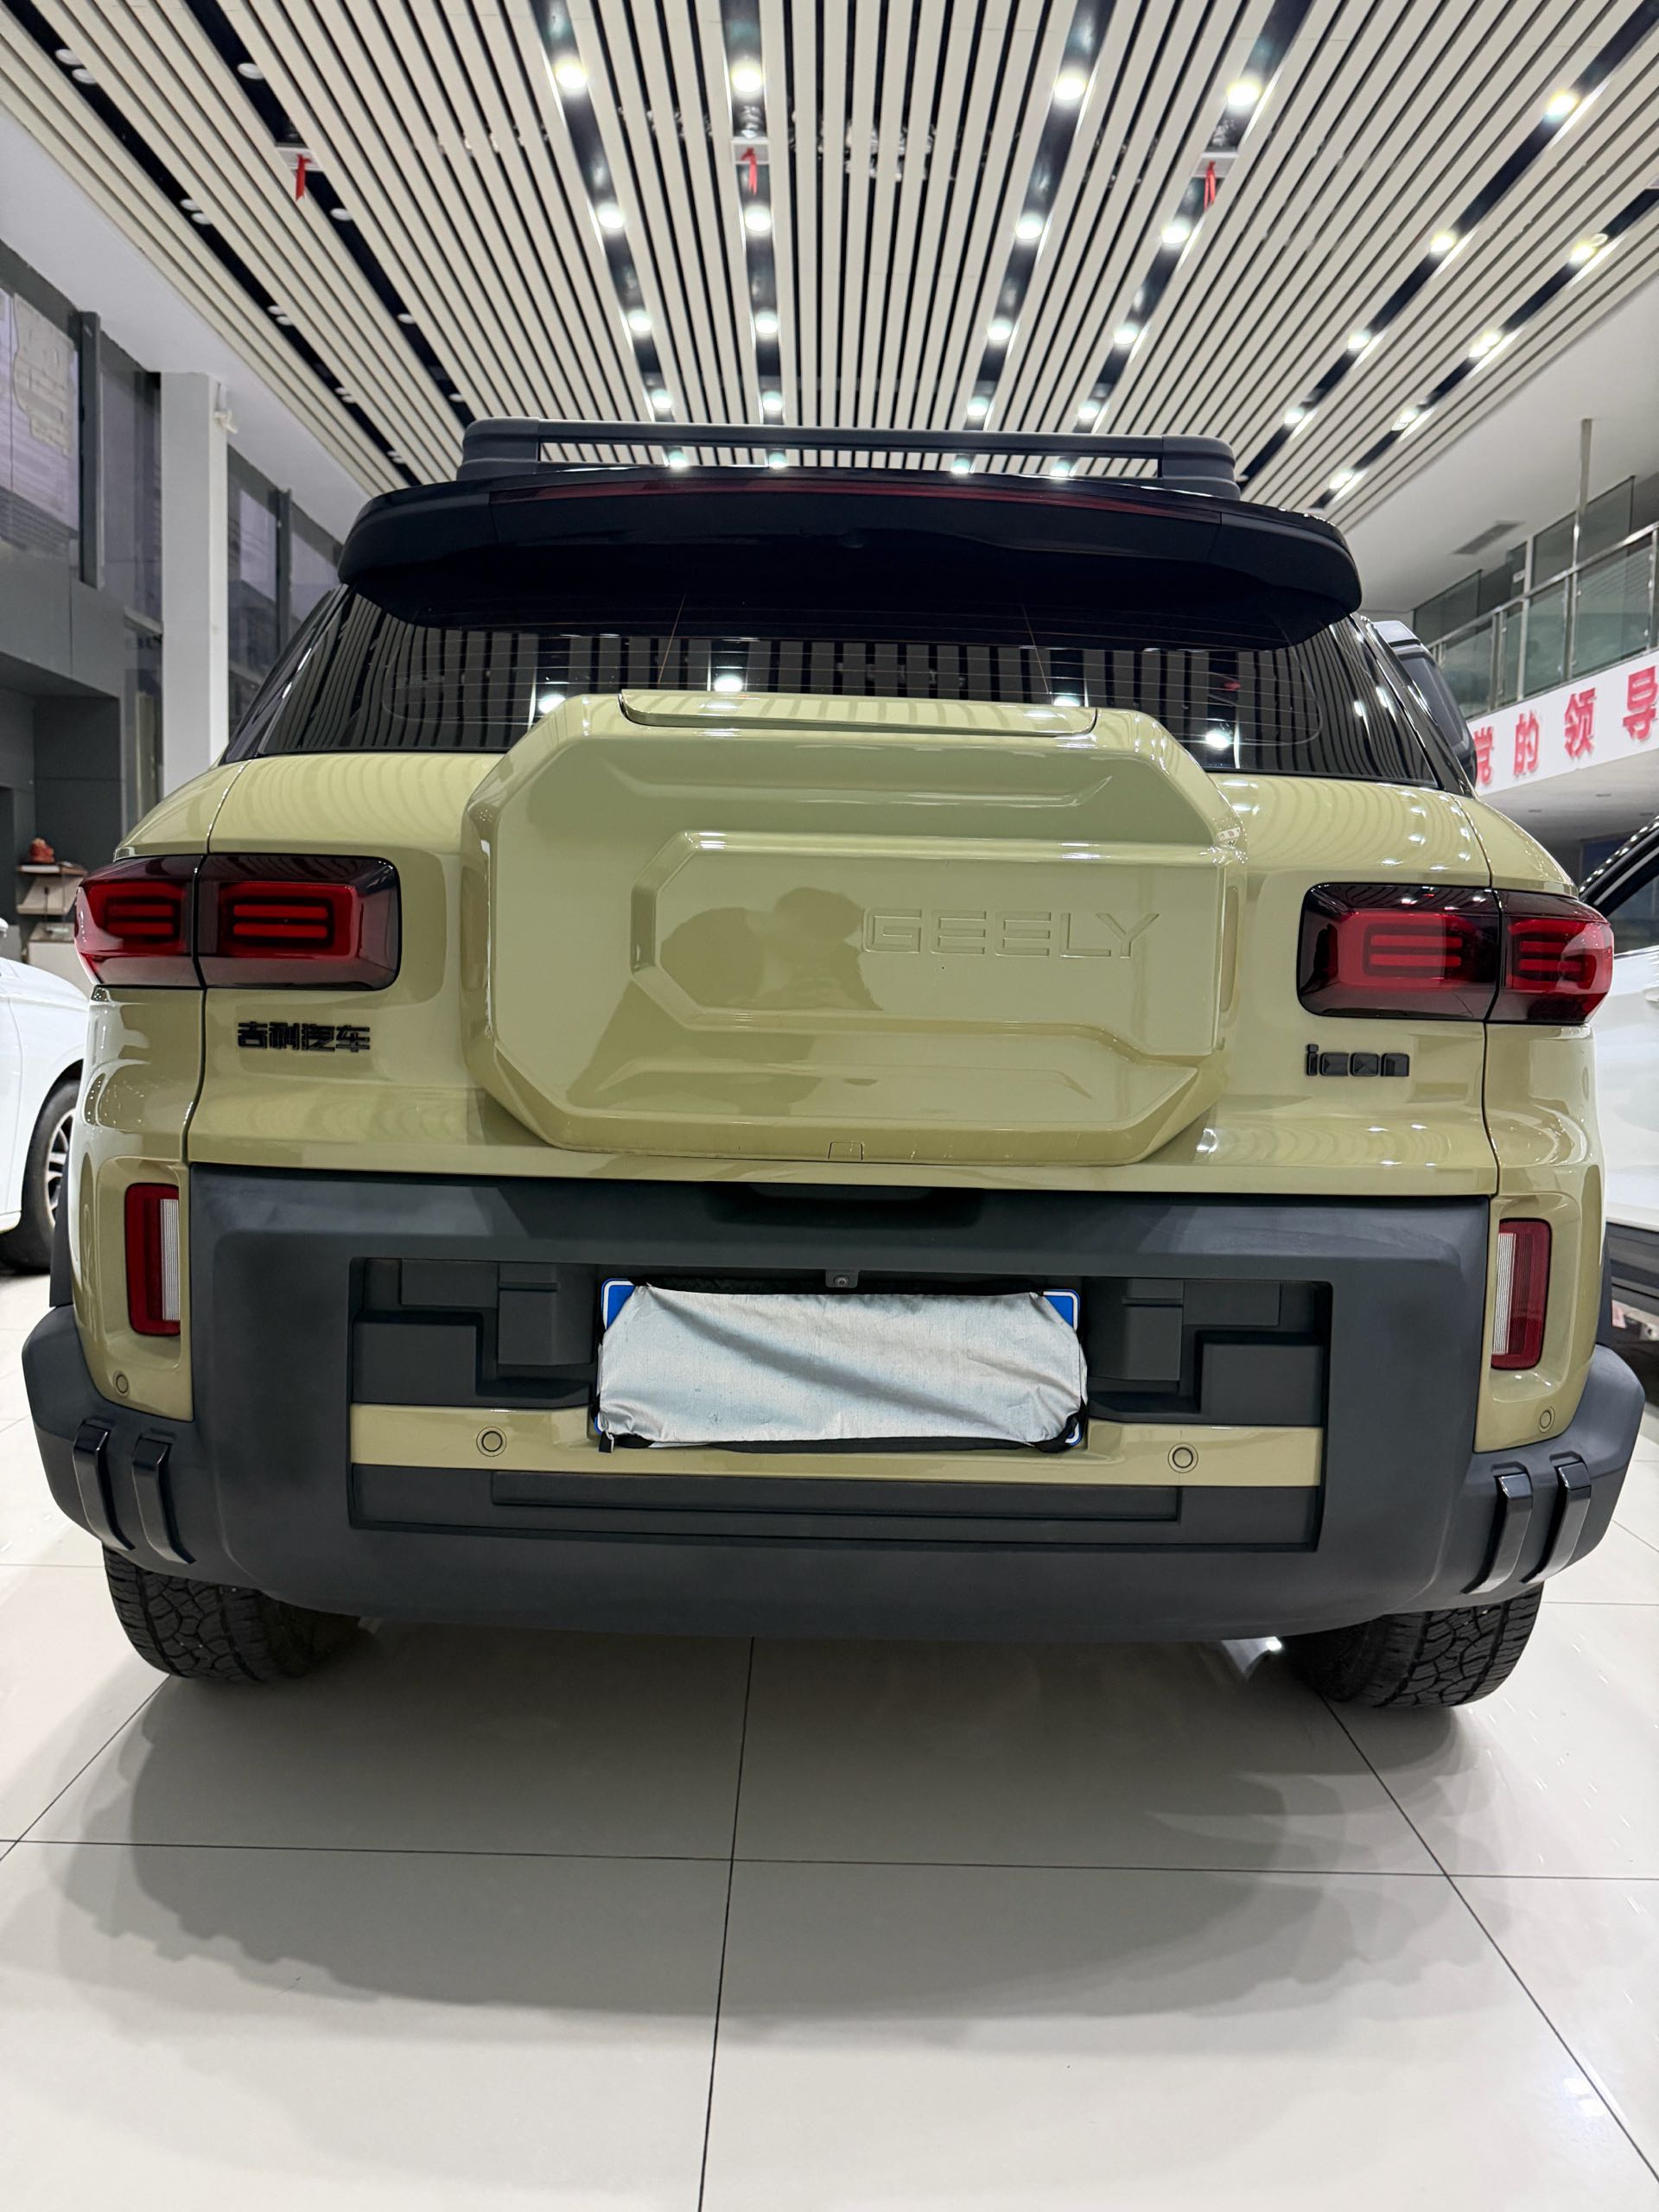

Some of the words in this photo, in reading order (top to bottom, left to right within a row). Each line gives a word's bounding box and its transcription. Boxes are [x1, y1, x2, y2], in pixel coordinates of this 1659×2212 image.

[863, 908, 1160, 959] GEELY
[238, 1021, 370, 1052] 吉利汽车
[1306, 1043, 1410, 1077] icon
